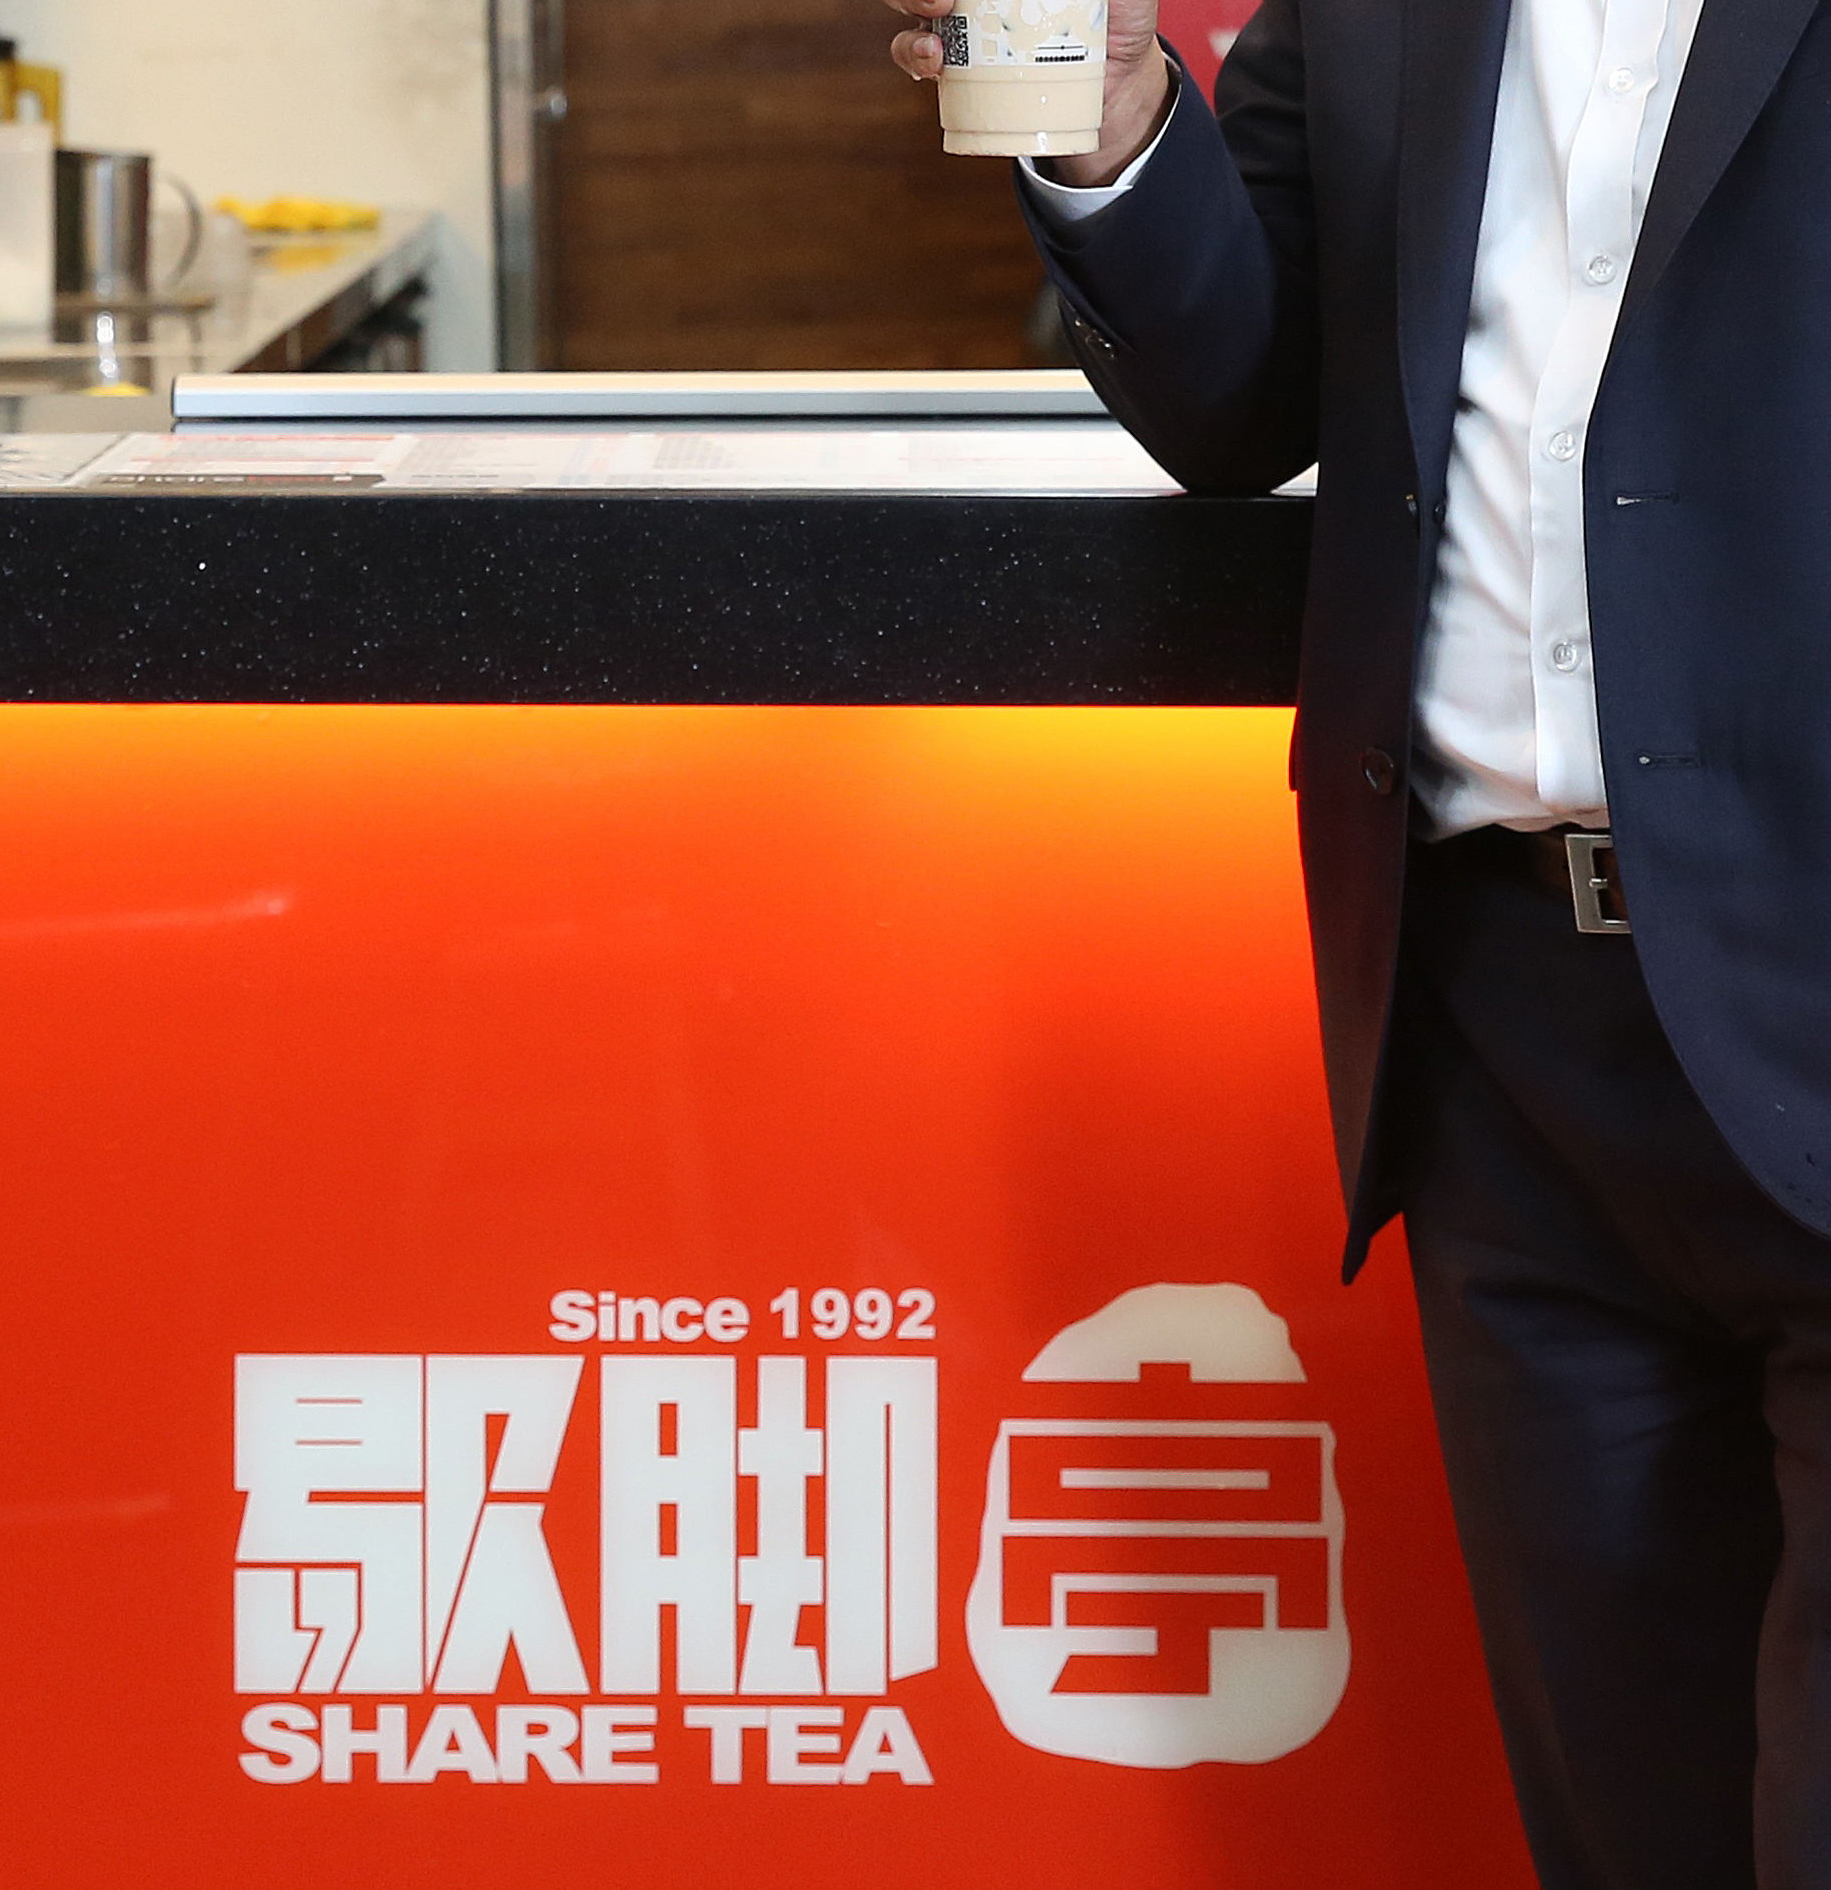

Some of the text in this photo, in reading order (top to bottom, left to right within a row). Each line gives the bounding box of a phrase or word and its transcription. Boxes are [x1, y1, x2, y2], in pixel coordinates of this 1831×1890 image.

[549, 1288, 936, 1343] Since 1992
[239, 1703, 935, 1785] SHARE TEA
